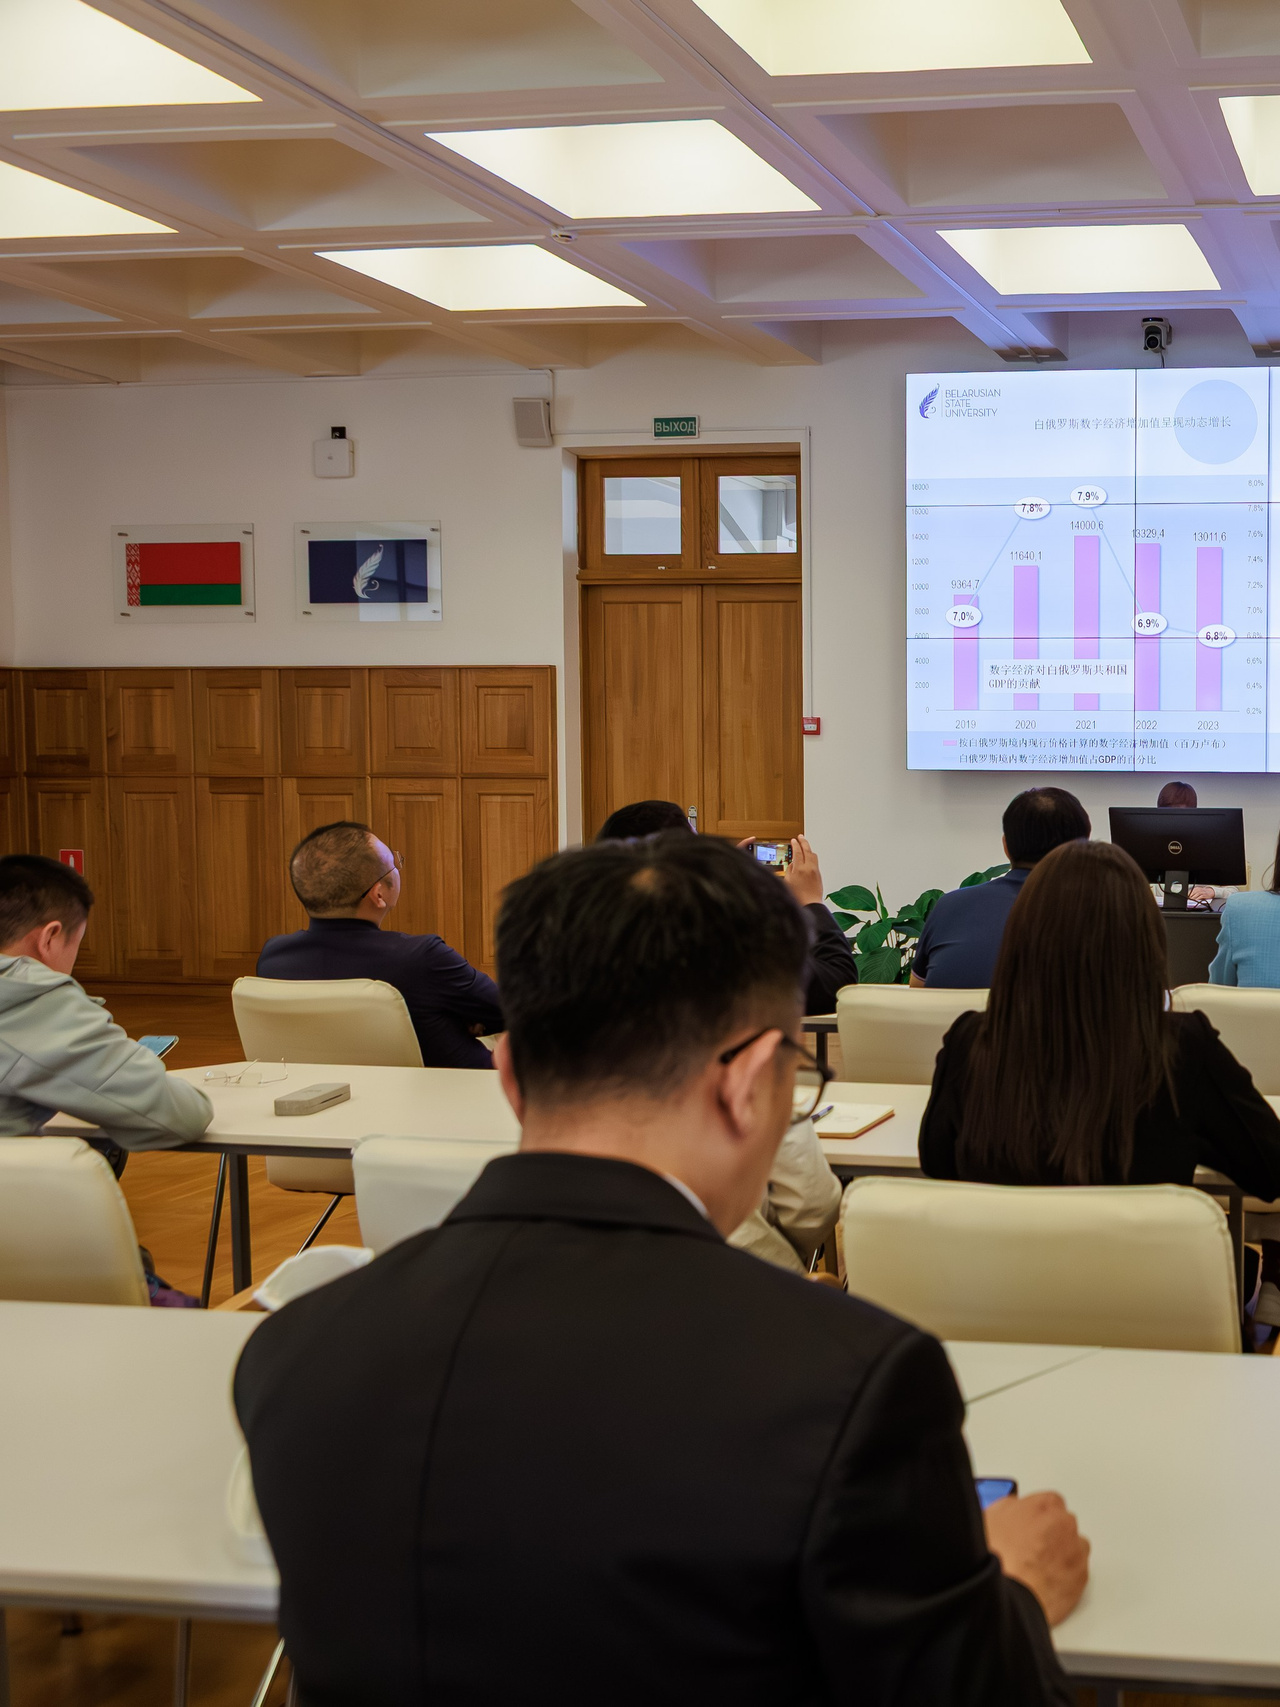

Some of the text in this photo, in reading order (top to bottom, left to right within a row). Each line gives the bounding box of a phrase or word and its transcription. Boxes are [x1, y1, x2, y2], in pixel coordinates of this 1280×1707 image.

[945, 388, 1001, 398] BELARUSIAN
[945, 399, 971, 408] STATE
[945, 408, 998, 418] UNIVERSITY
[655, 421, 695, 433] ВЫХОД
[1077, 491, 1100, 502] 7,9%
[1021, 503, 1043, 514] 7,8%
[1248, 505, 1264, 513] 7,8%
[1070, 520, 1104, 532] 14000,6
[1132, 529, 1165, 540] 13329,4
[1193, 531, 1227, 543] 13011,6
[1248, 530, 1263, 538] 7,6%
[1010, 551, 1042, 562] 11640,1
[1247, 556, 1263, 564] 7,4%
[951, 579, 980, 590] 9364,7
[1247, 581, 1263, 590] 7,2%
[953, 611, 974, 622] 7,0%
[1138, 618, 1160, 629] 6,9%
[1206, 631, 1228, 643] 6,8%
[990, 664, 1127, 676] 数字经济对白俄罗斯共和国
[988, 678, 1041, 690] GDP的贡献
[955, 719, 977, 730] 2019
[1015, 719, 1037, 730] 2020
[1075, 719, 1097, 730] 2021
[1136, 720, 1158, 730] 2022
[1197, 720, 1220, 731] 2023
